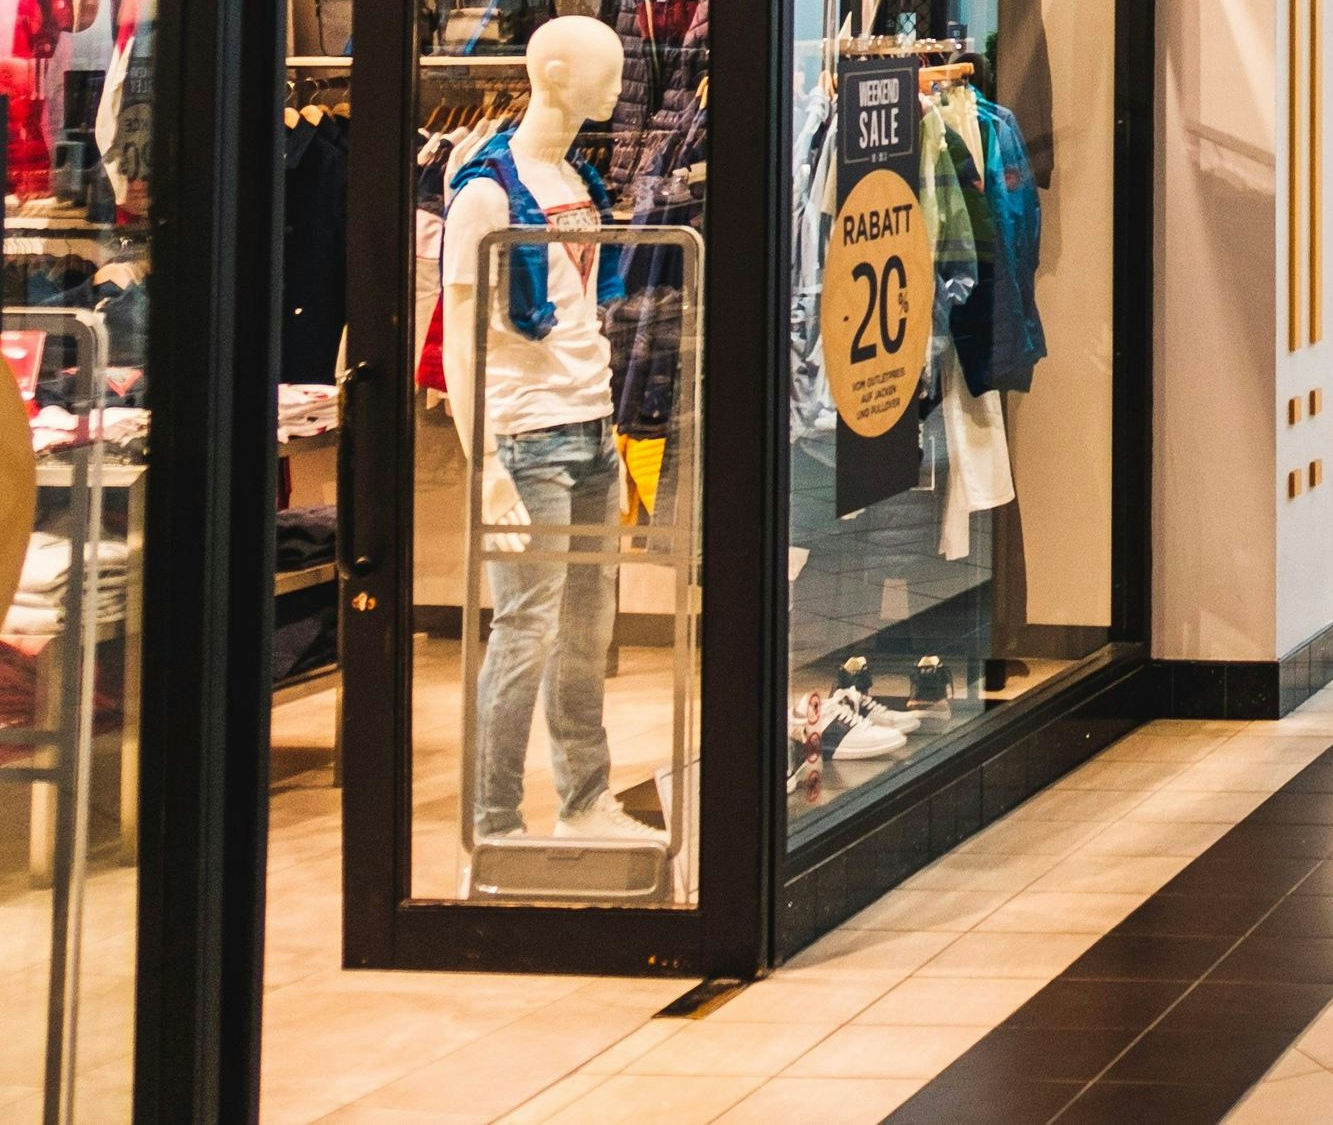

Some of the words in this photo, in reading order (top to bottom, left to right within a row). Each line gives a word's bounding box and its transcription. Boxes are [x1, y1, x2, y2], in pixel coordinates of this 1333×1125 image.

[859, 78, 899, 107] WEEKEND
[860, 108, 899, 149] SALE
[843, 204, 912, 246] RABATT
